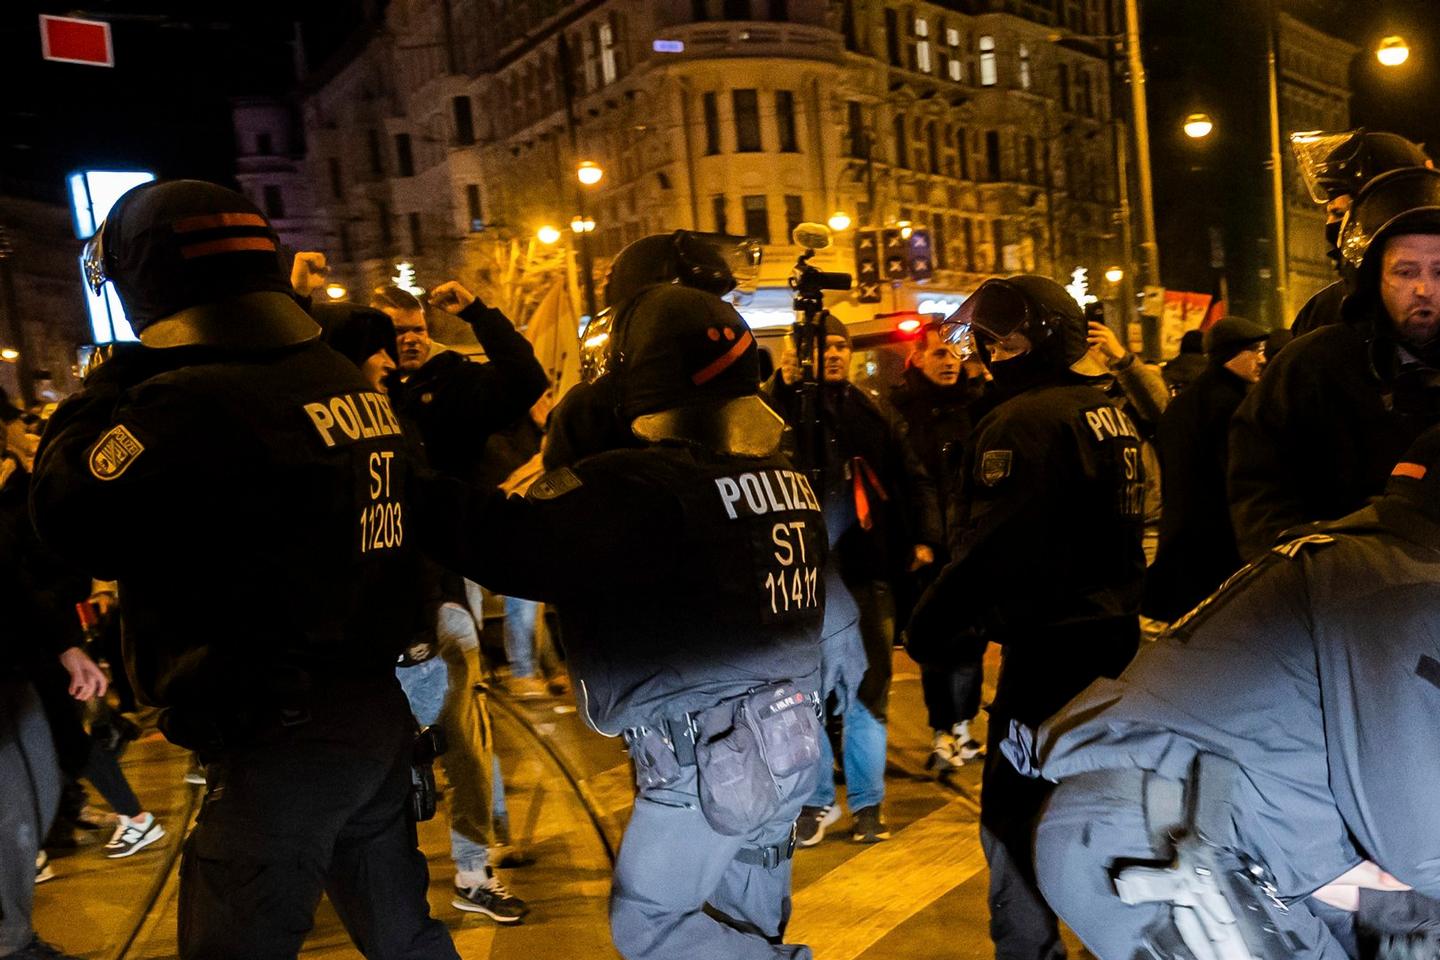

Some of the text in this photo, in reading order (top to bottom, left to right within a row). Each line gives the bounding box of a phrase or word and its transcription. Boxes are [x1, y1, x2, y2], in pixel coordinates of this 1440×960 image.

[369, 451, 395, 500] ST
[715, 470, 822, 520] POLIZEI
[360, 502, 403, 553] 11203
[772, 521, 806, 566] ST
[765, 567, 817, 614] 11411
